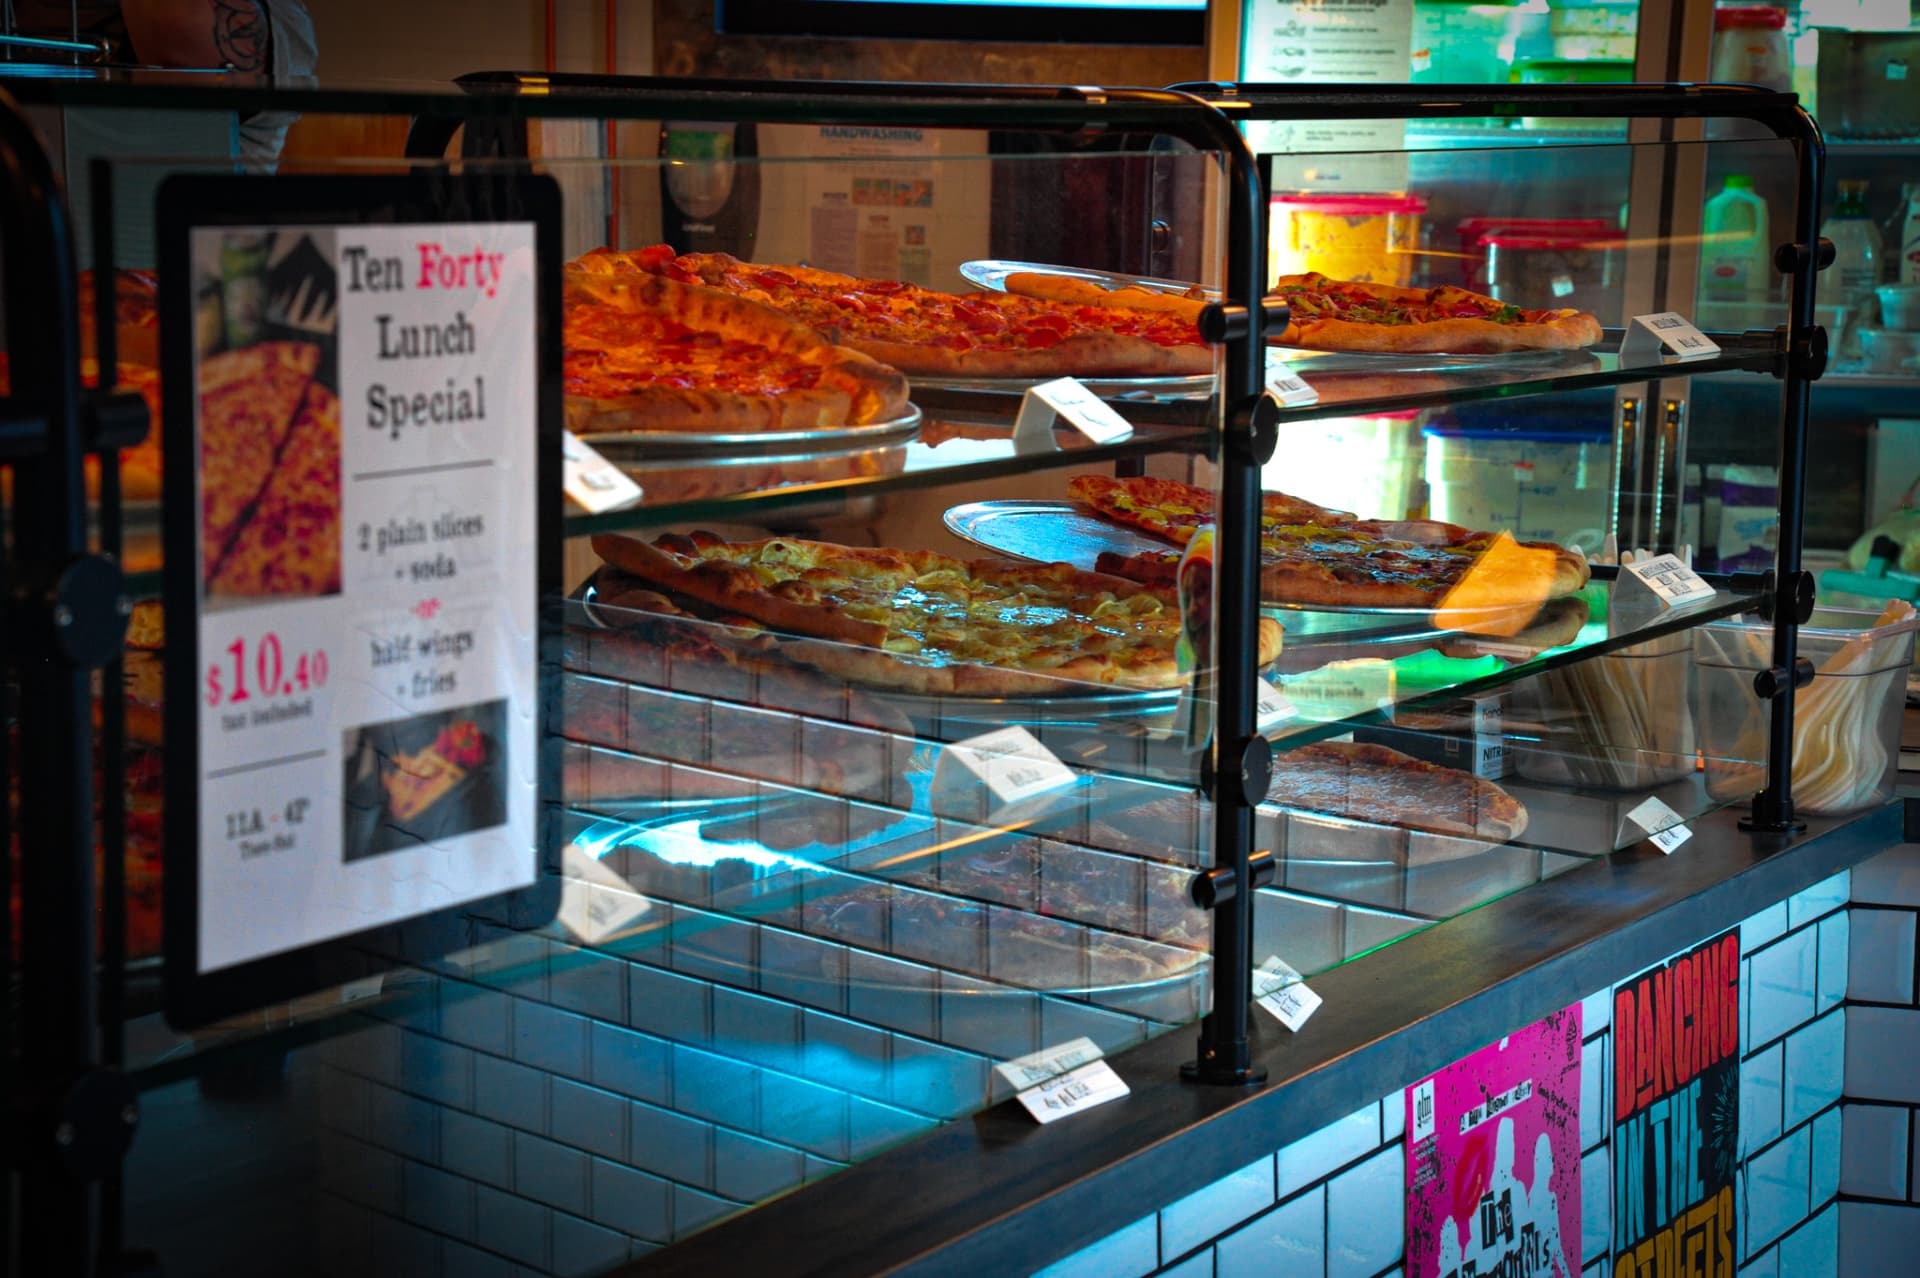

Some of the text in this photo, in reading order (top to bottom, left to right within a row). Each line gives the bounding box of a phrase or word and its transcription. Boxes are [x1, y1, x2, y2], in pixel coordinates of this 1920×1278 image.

[342, 242, 503, 298] Ten Forty
[375, 311, 475, 361] Lunch
[366, 376, 486, 440] Special
[204, 630, 331, 709] $10.40
[1616, 934, 1737, 1121] DANCING
[1615, 1077, 1704, 1251] IN THE
[1481, 1187, 1514, 1250] The
[1614, 1184, 1733, 1278] EETS
